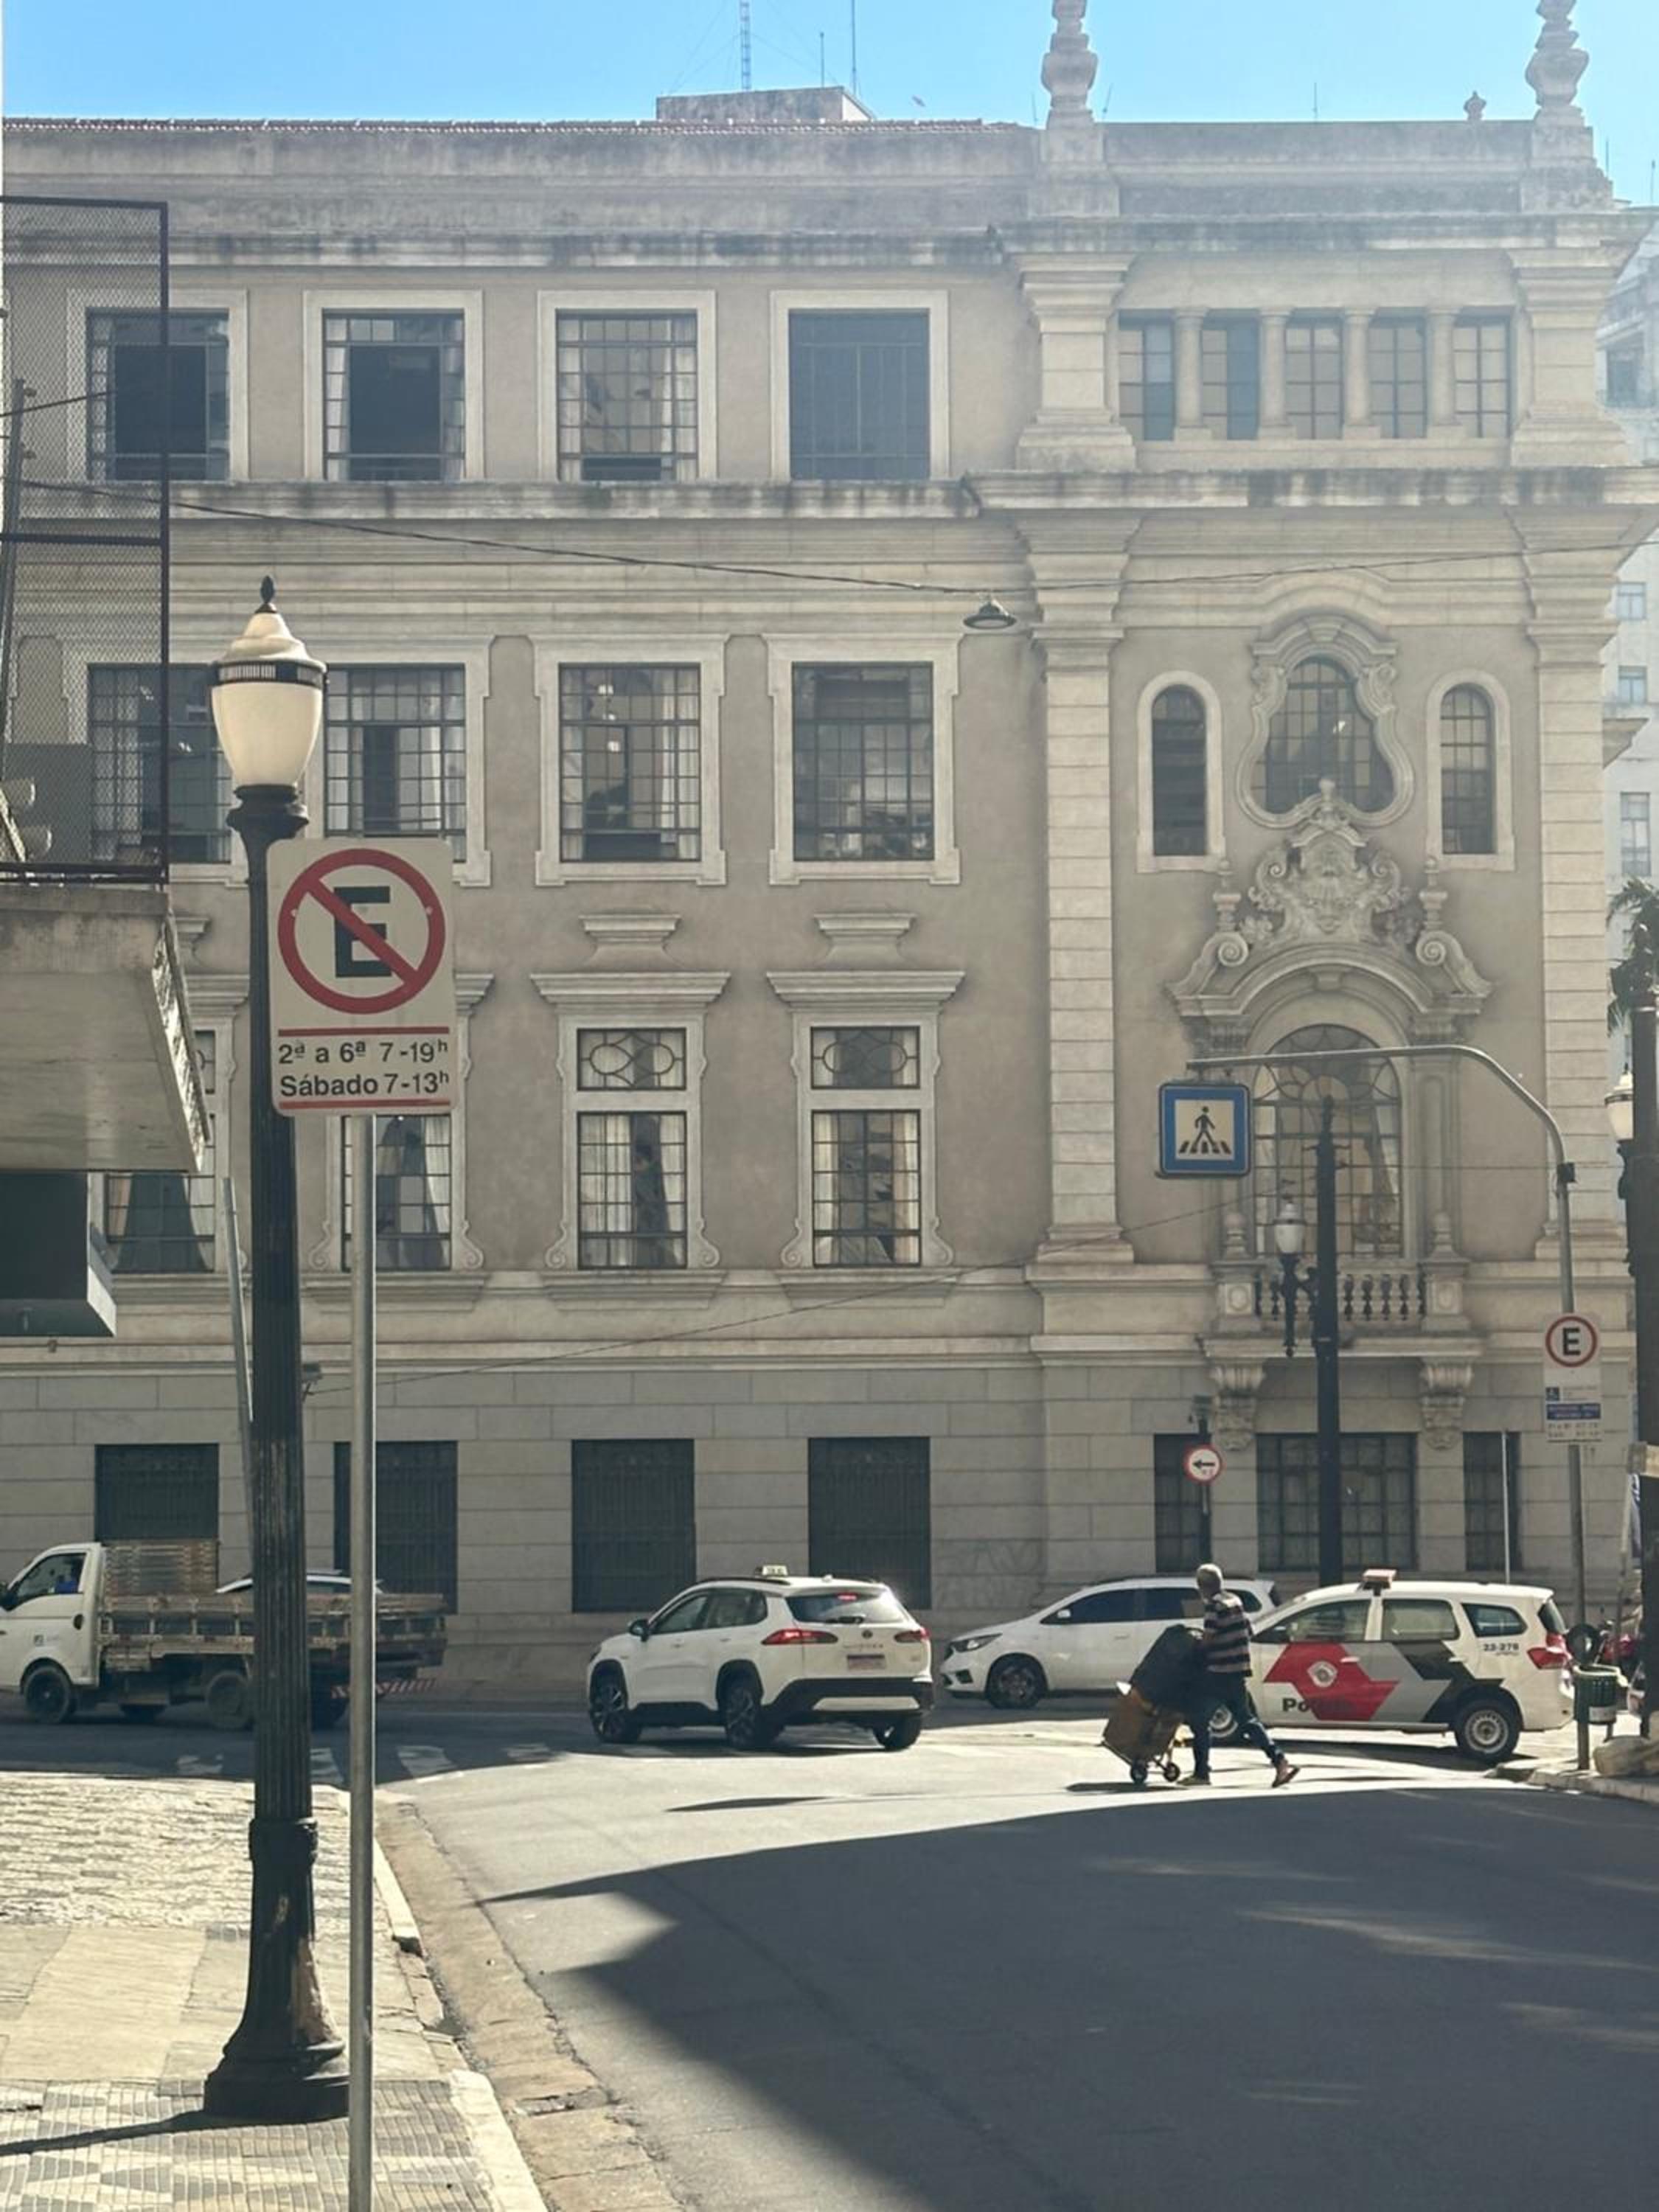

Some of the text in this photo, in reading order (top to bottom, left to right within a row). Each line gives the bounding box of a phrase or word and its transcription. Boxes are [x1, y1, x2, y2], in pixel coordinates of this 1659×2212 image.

[334, 886, 392, 978] E
[316, 1047, 330, 1063] a
[280, 1073, 378, 1097] Sábado
[1562, 1328, 1581, 1355] E
